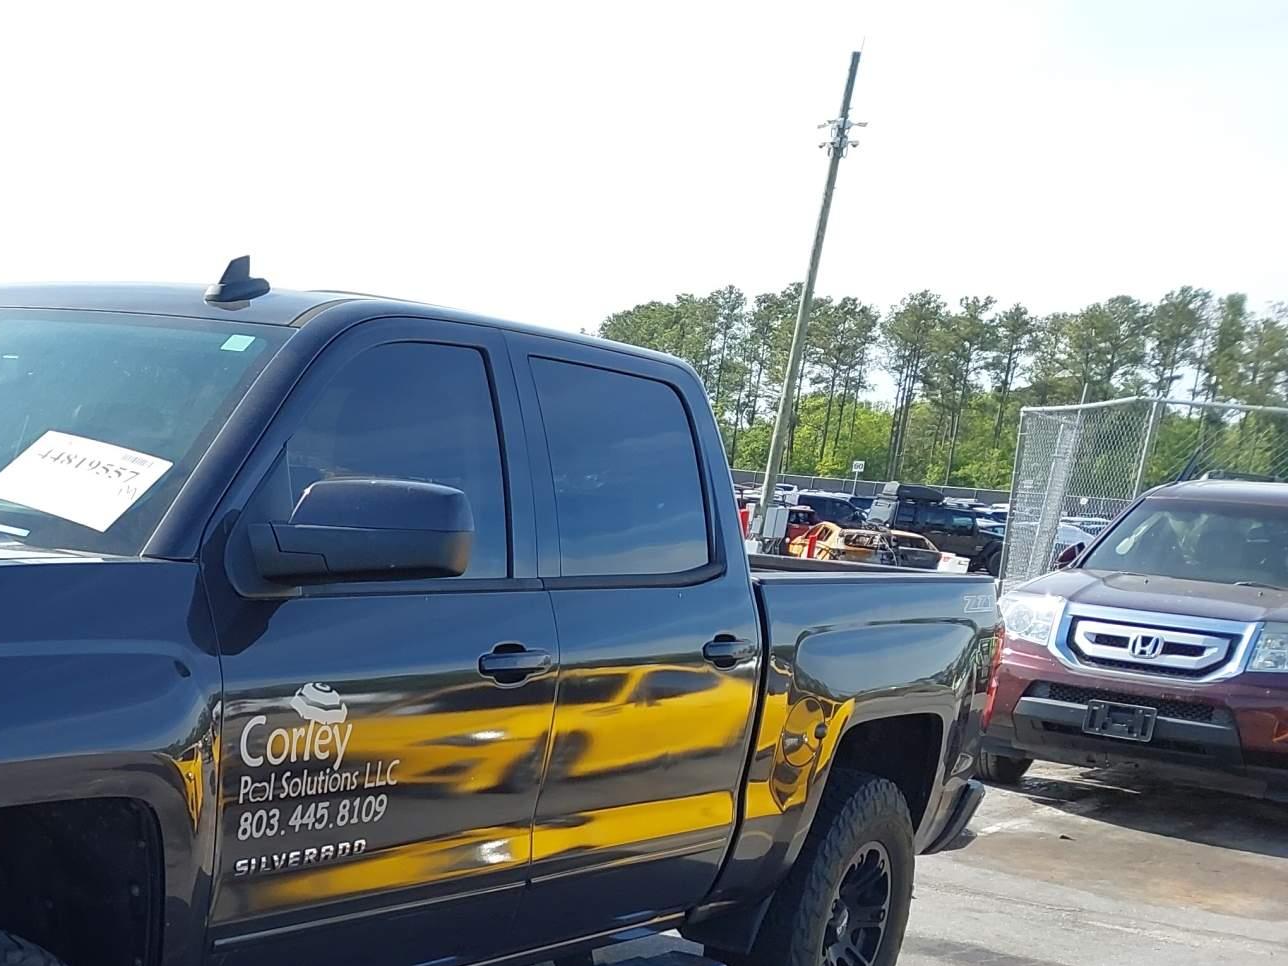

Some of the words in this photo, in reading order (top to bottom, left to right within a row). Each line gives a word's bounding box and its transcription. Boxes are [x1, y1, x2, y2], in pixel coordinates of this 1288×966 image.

[240, 715, 352, 770] Corley
[280, 768, 359, 799] Solutions
[364, 759, 400, 789] LLC
[234, 839, 367, 876] SILVERADO
